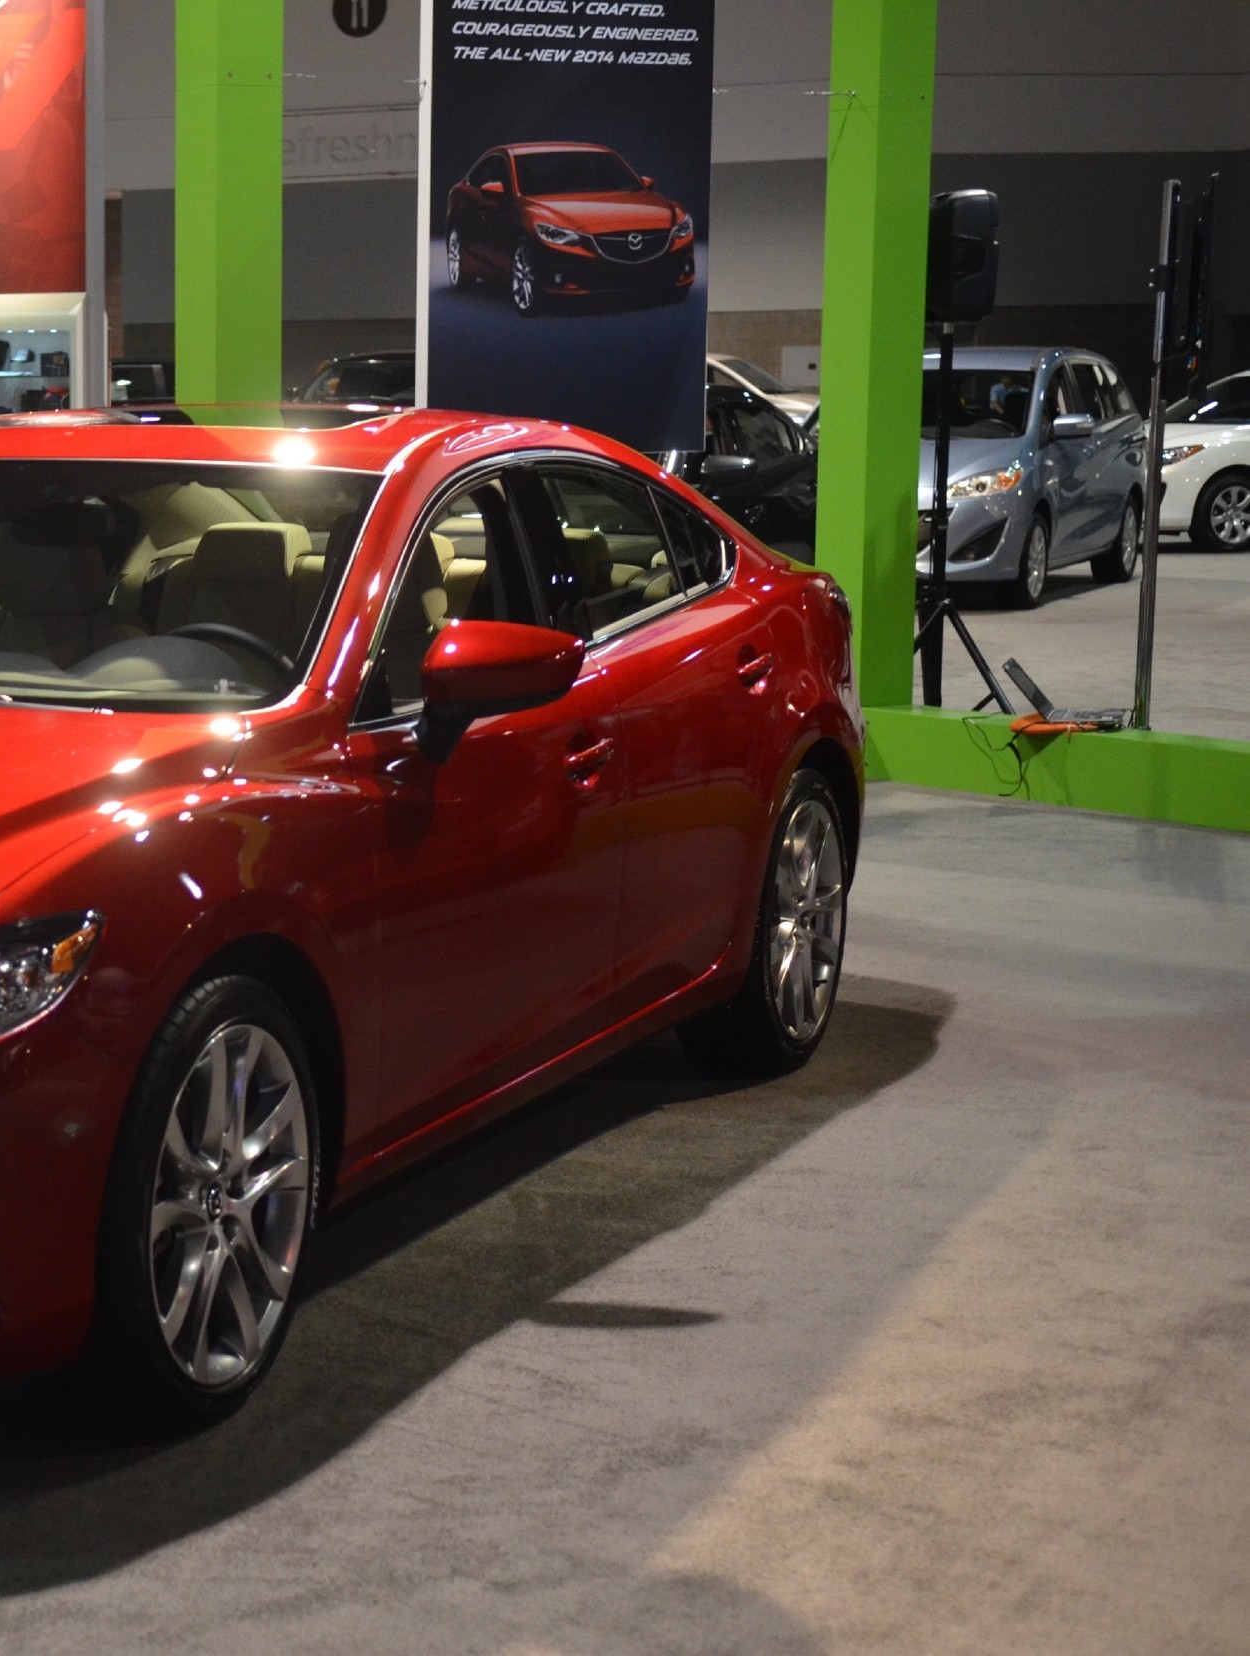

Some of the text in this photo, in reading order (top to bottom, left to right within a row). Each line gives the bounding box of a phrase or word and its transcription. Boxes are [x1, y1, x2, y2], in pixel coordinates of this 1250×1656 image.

[451, 0, 665, 17] METICULOUSLY CRAFTED.
[451, 21, 699, 42] COURAGEOUSLY ENGINEERED.
[453, 46, 489, 60] THE
[489, 47, 572, 63] ALL-NEW
[572, 49, 615, 64] 2014
